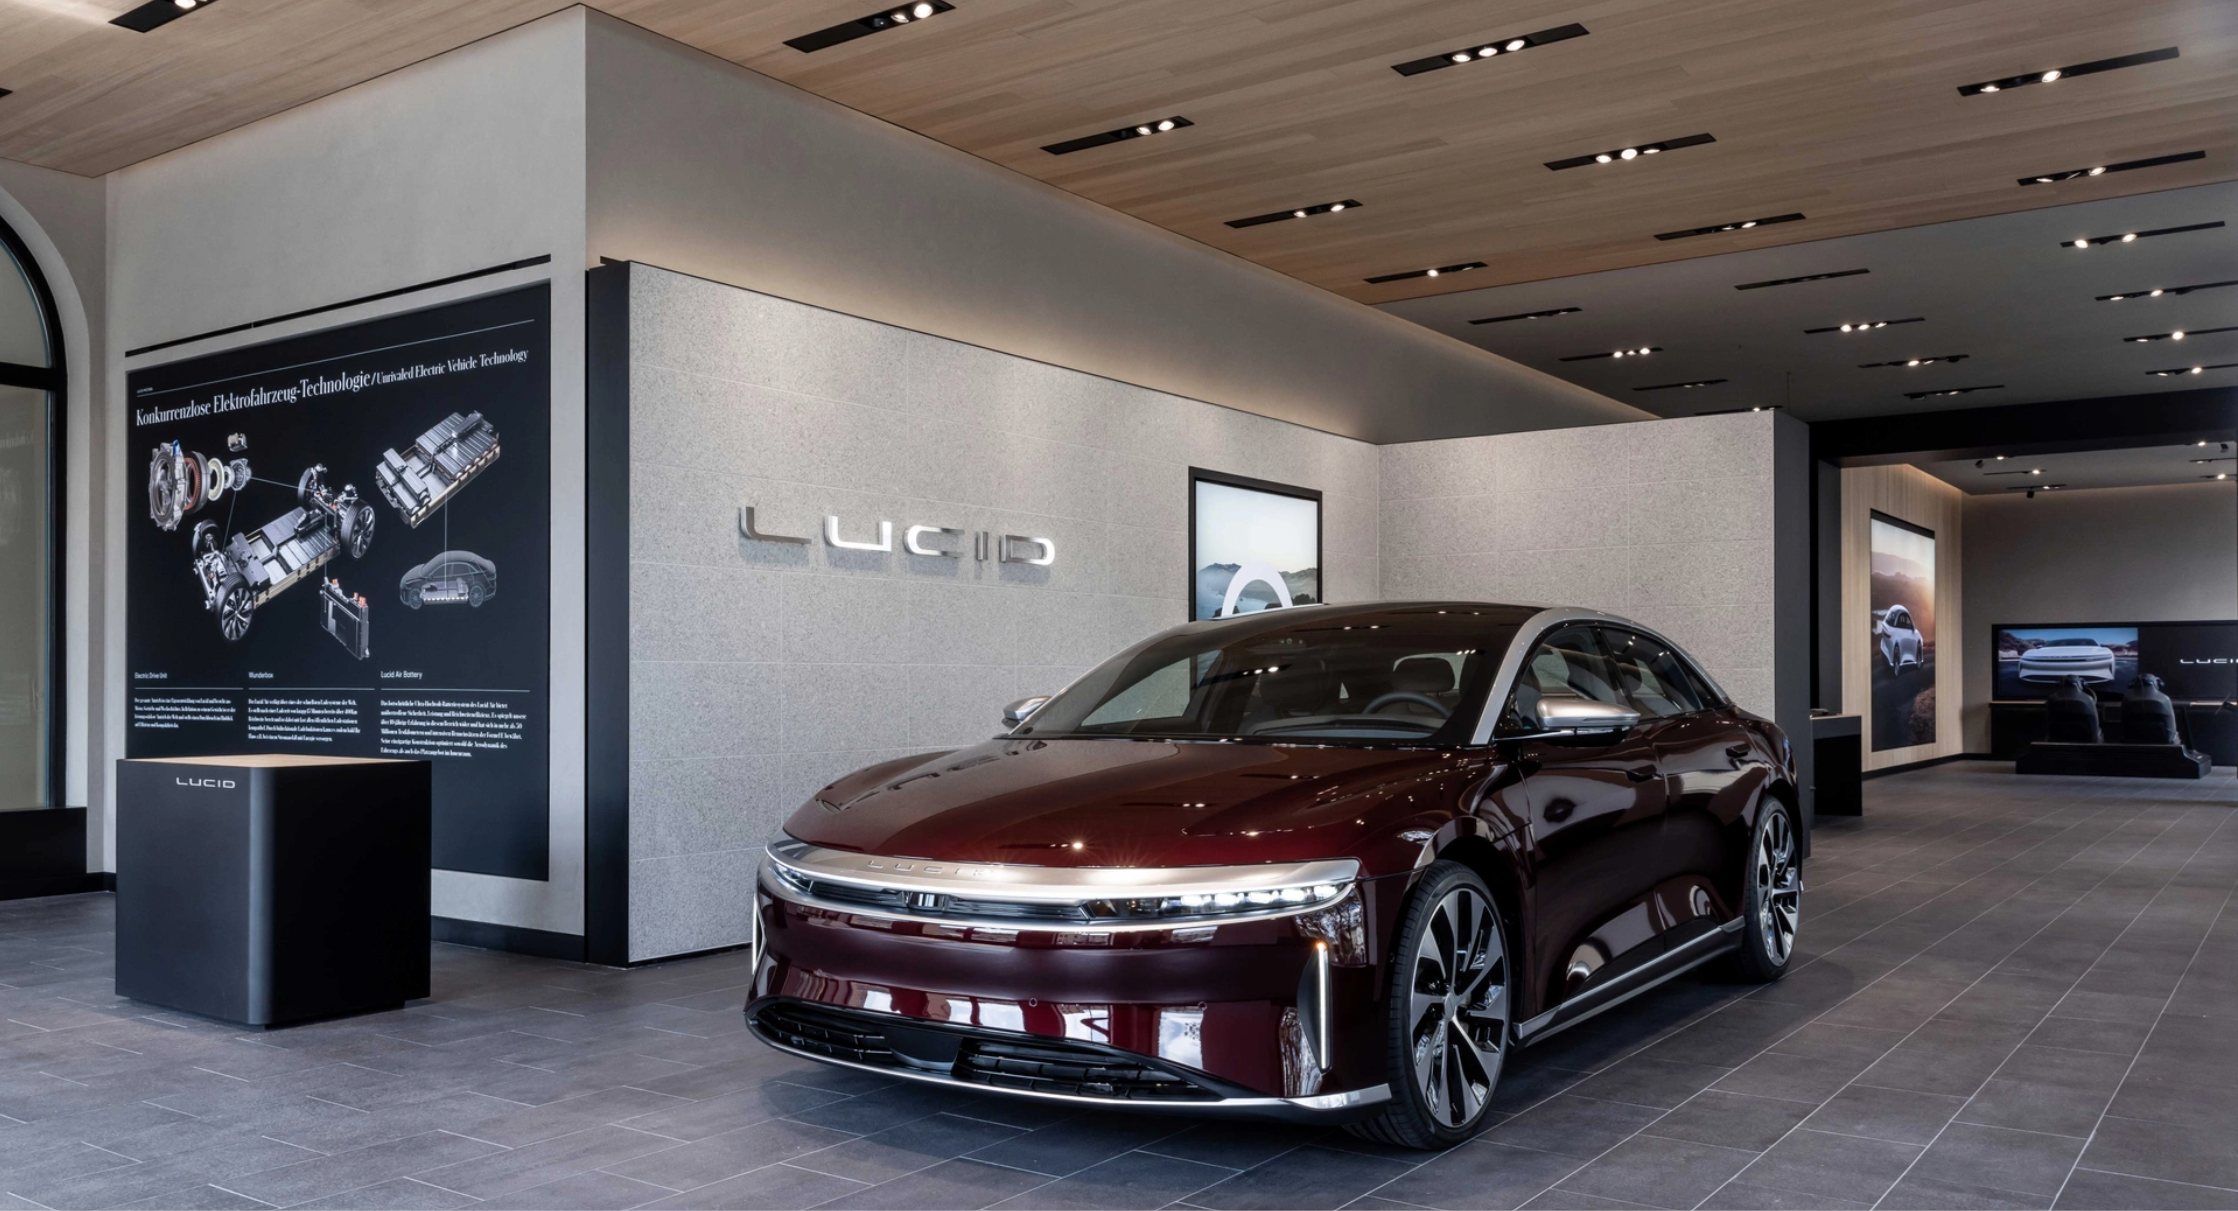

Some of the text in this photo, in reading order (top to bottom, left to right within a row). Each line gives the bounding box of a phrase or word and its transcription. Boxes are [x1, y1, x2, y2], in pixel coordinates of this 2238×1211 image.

[136, 400, 211, 426] Konkurrenzlose
[415, 363, 446, 379] Electric
[448, 356, 478, 373] Vehicle
[479, 349, 529, 368] Technology
[739, 506, 1055, 566] LUCID
[380, 671, 395, 679] Lucid
[403, 671, 423, 680] Battery
[175, 777, 236, 789] LUCID
